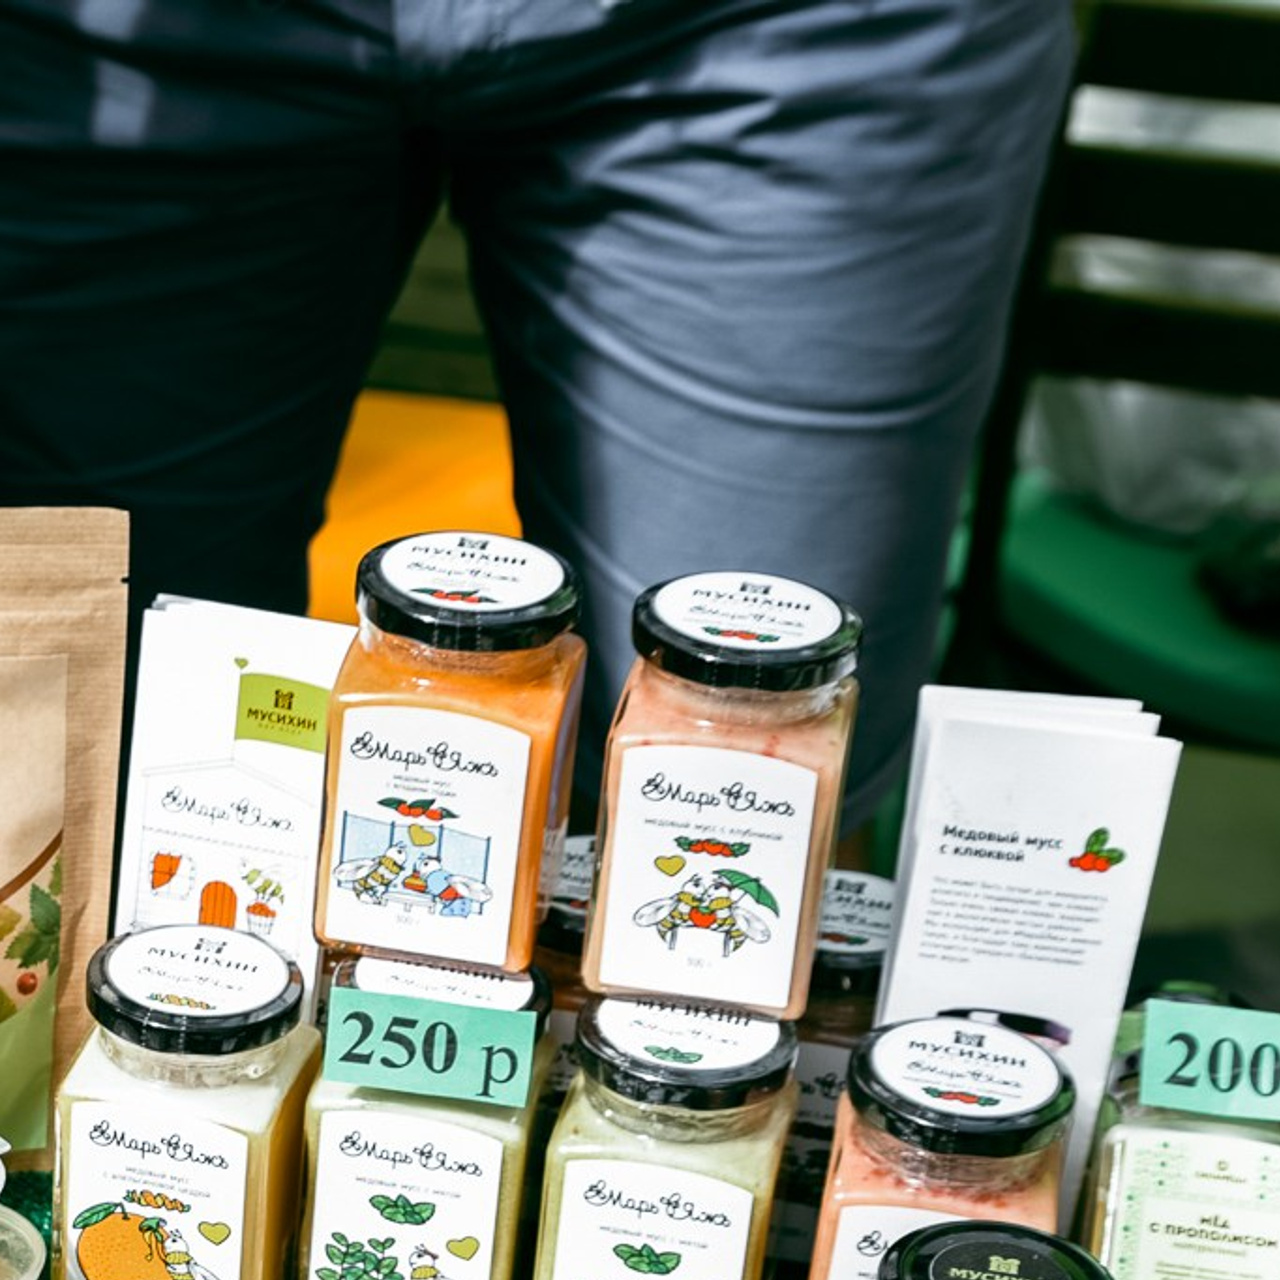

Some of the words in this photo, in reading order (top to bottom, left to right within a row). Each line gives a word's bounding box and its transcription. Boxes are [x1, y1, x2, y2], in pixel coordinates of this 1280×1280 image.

[247, 706, 318, 732] МУСИХИН
[943, 824, 1019, 843] Медовый
[1025, 836, 1063, 851] мусс
[953, 844, 1024, 862] клюквой
[338, 1011, 458, 1074] 250
[1164, 1032, 1280, 1098] 200
